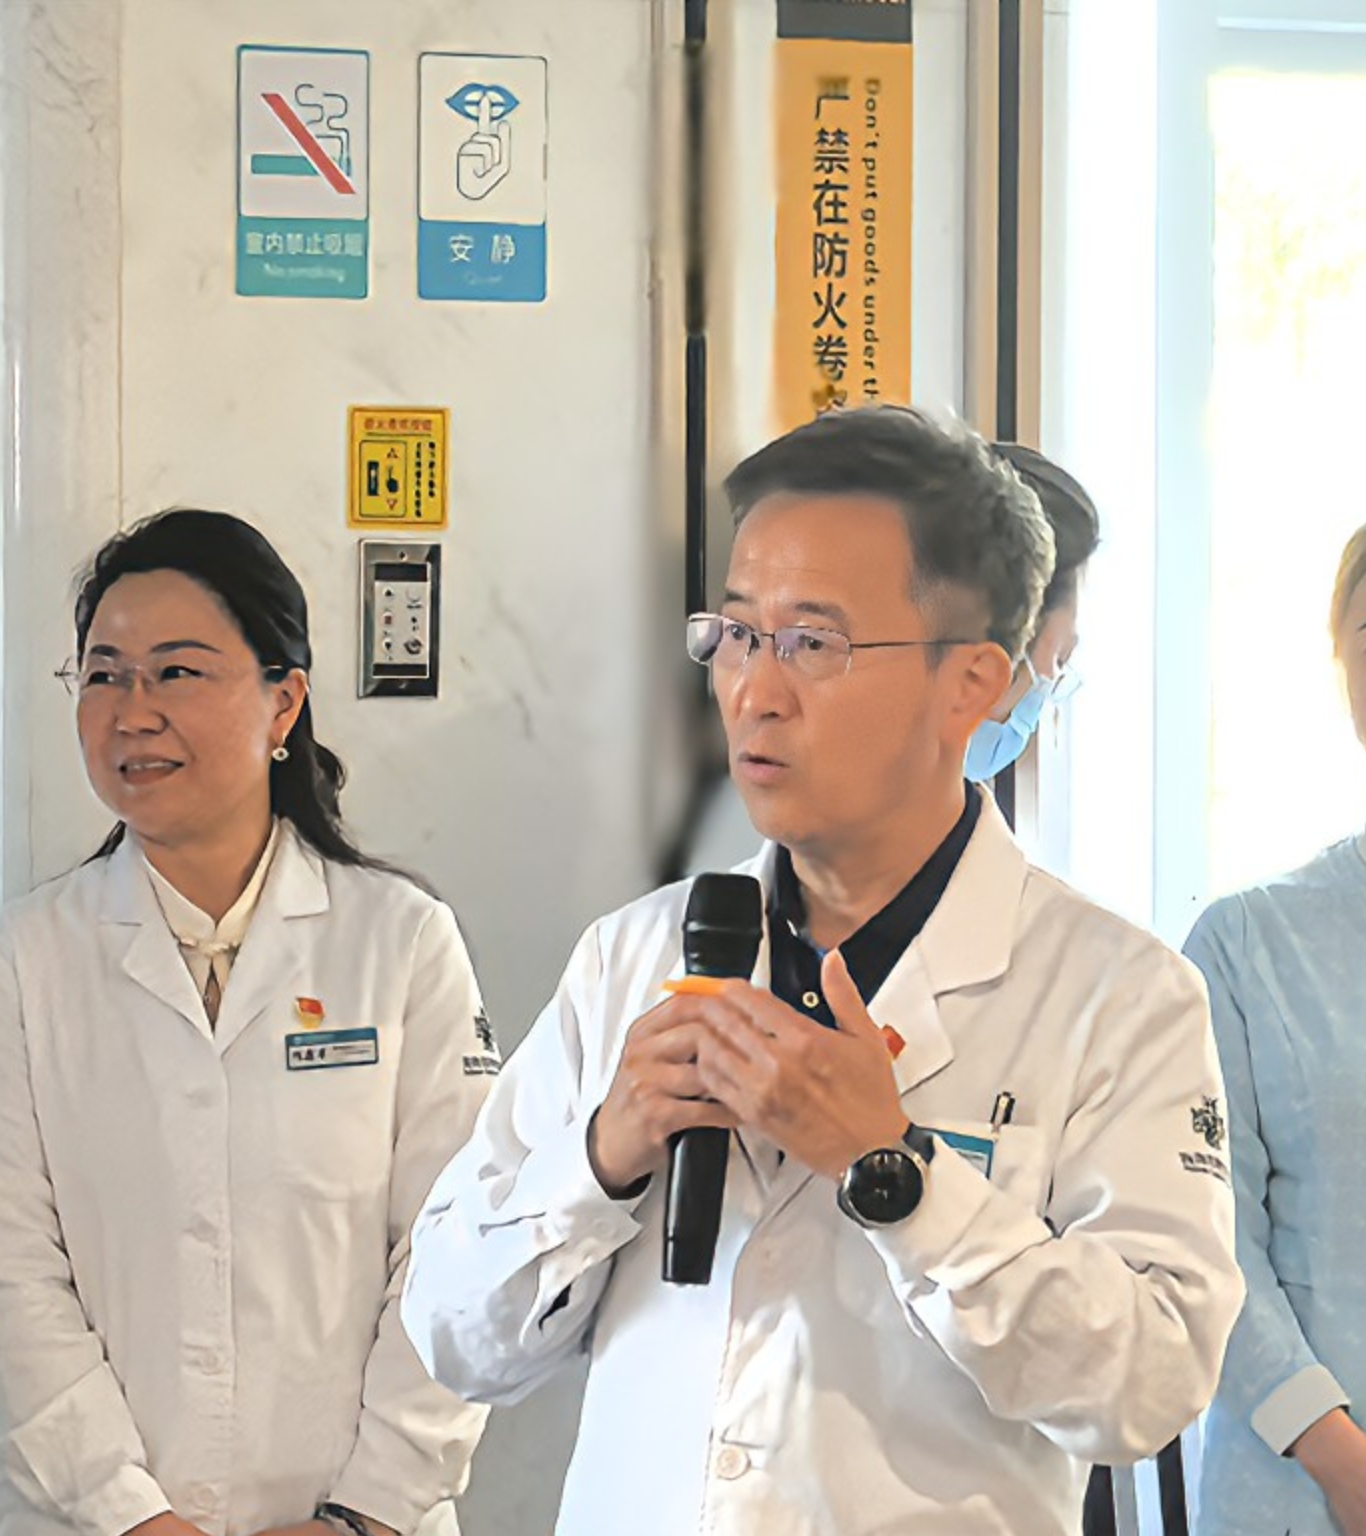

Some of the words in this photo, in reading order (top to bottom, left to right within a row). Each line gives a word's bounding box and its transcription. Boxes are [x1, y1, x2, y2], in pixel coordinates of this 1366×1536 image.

[864, 78, 881, 149] Don't
[861, 157, 879, 199] put
[449, 234, 516, 264] 安静
[812, 75, 851, 413] 严禁在防火卷
[861, 208, 881, 287] goods
[863, 295, 880, 370] under
